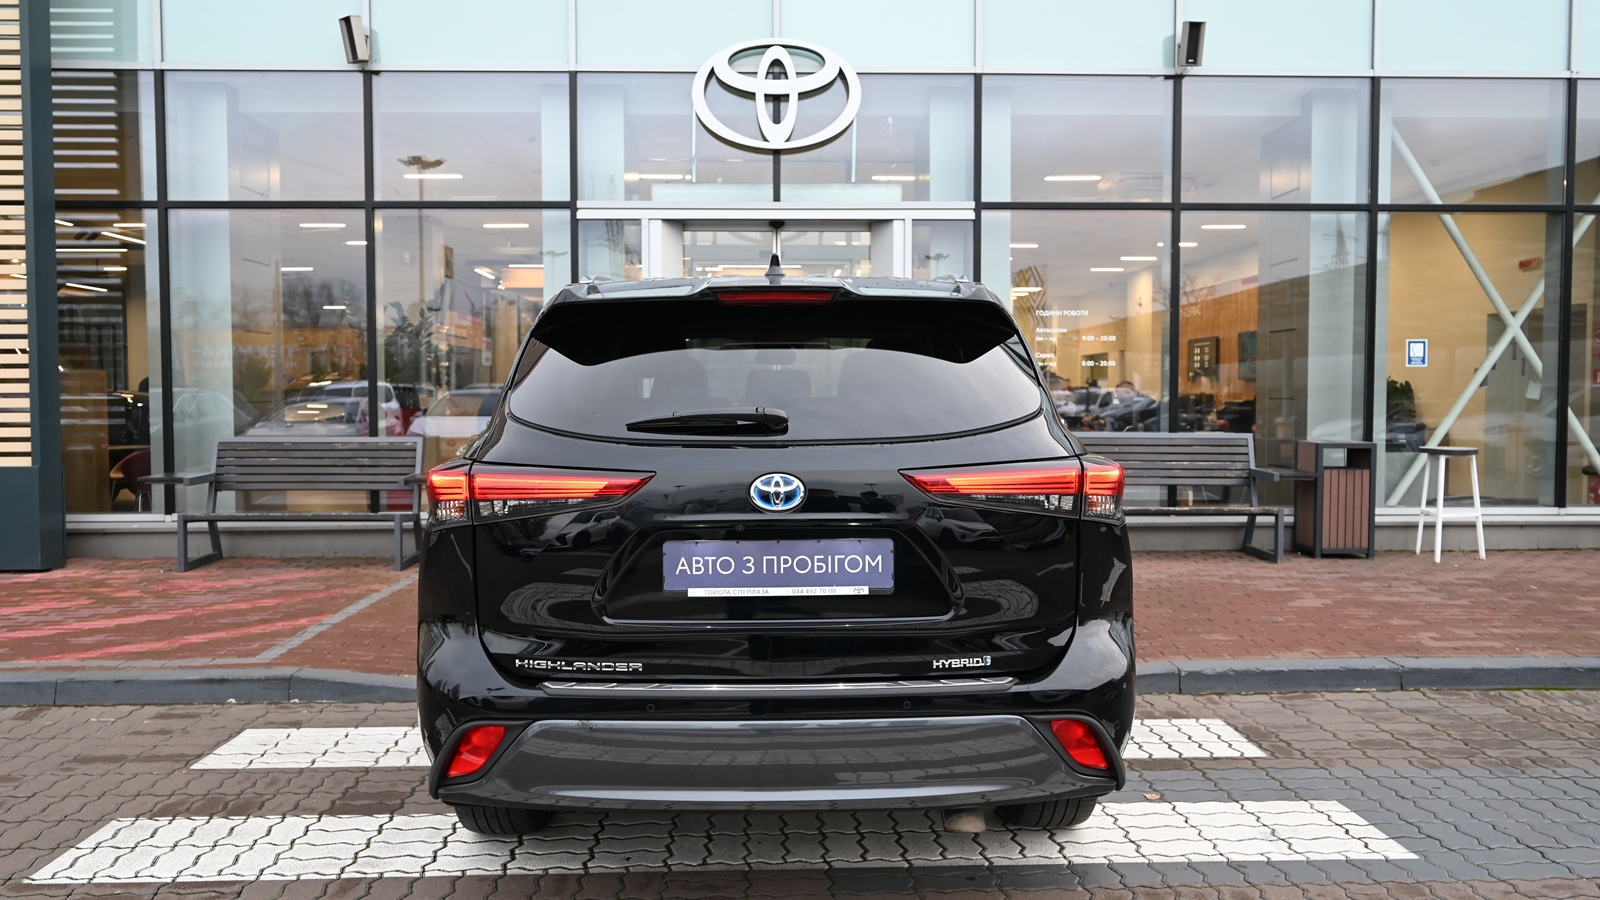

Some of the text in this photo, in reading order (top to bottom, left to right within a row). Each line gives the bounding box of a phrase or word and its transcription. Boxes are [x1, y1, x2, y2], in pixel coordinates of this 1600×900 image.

[675, 556, 735, 575] АВТО
[763, 554, 882, 574] ПРОБІГОМ
[515, 659, 643, 672] HIGHLANDER
[932, 657, 982, 669] HYBRID
